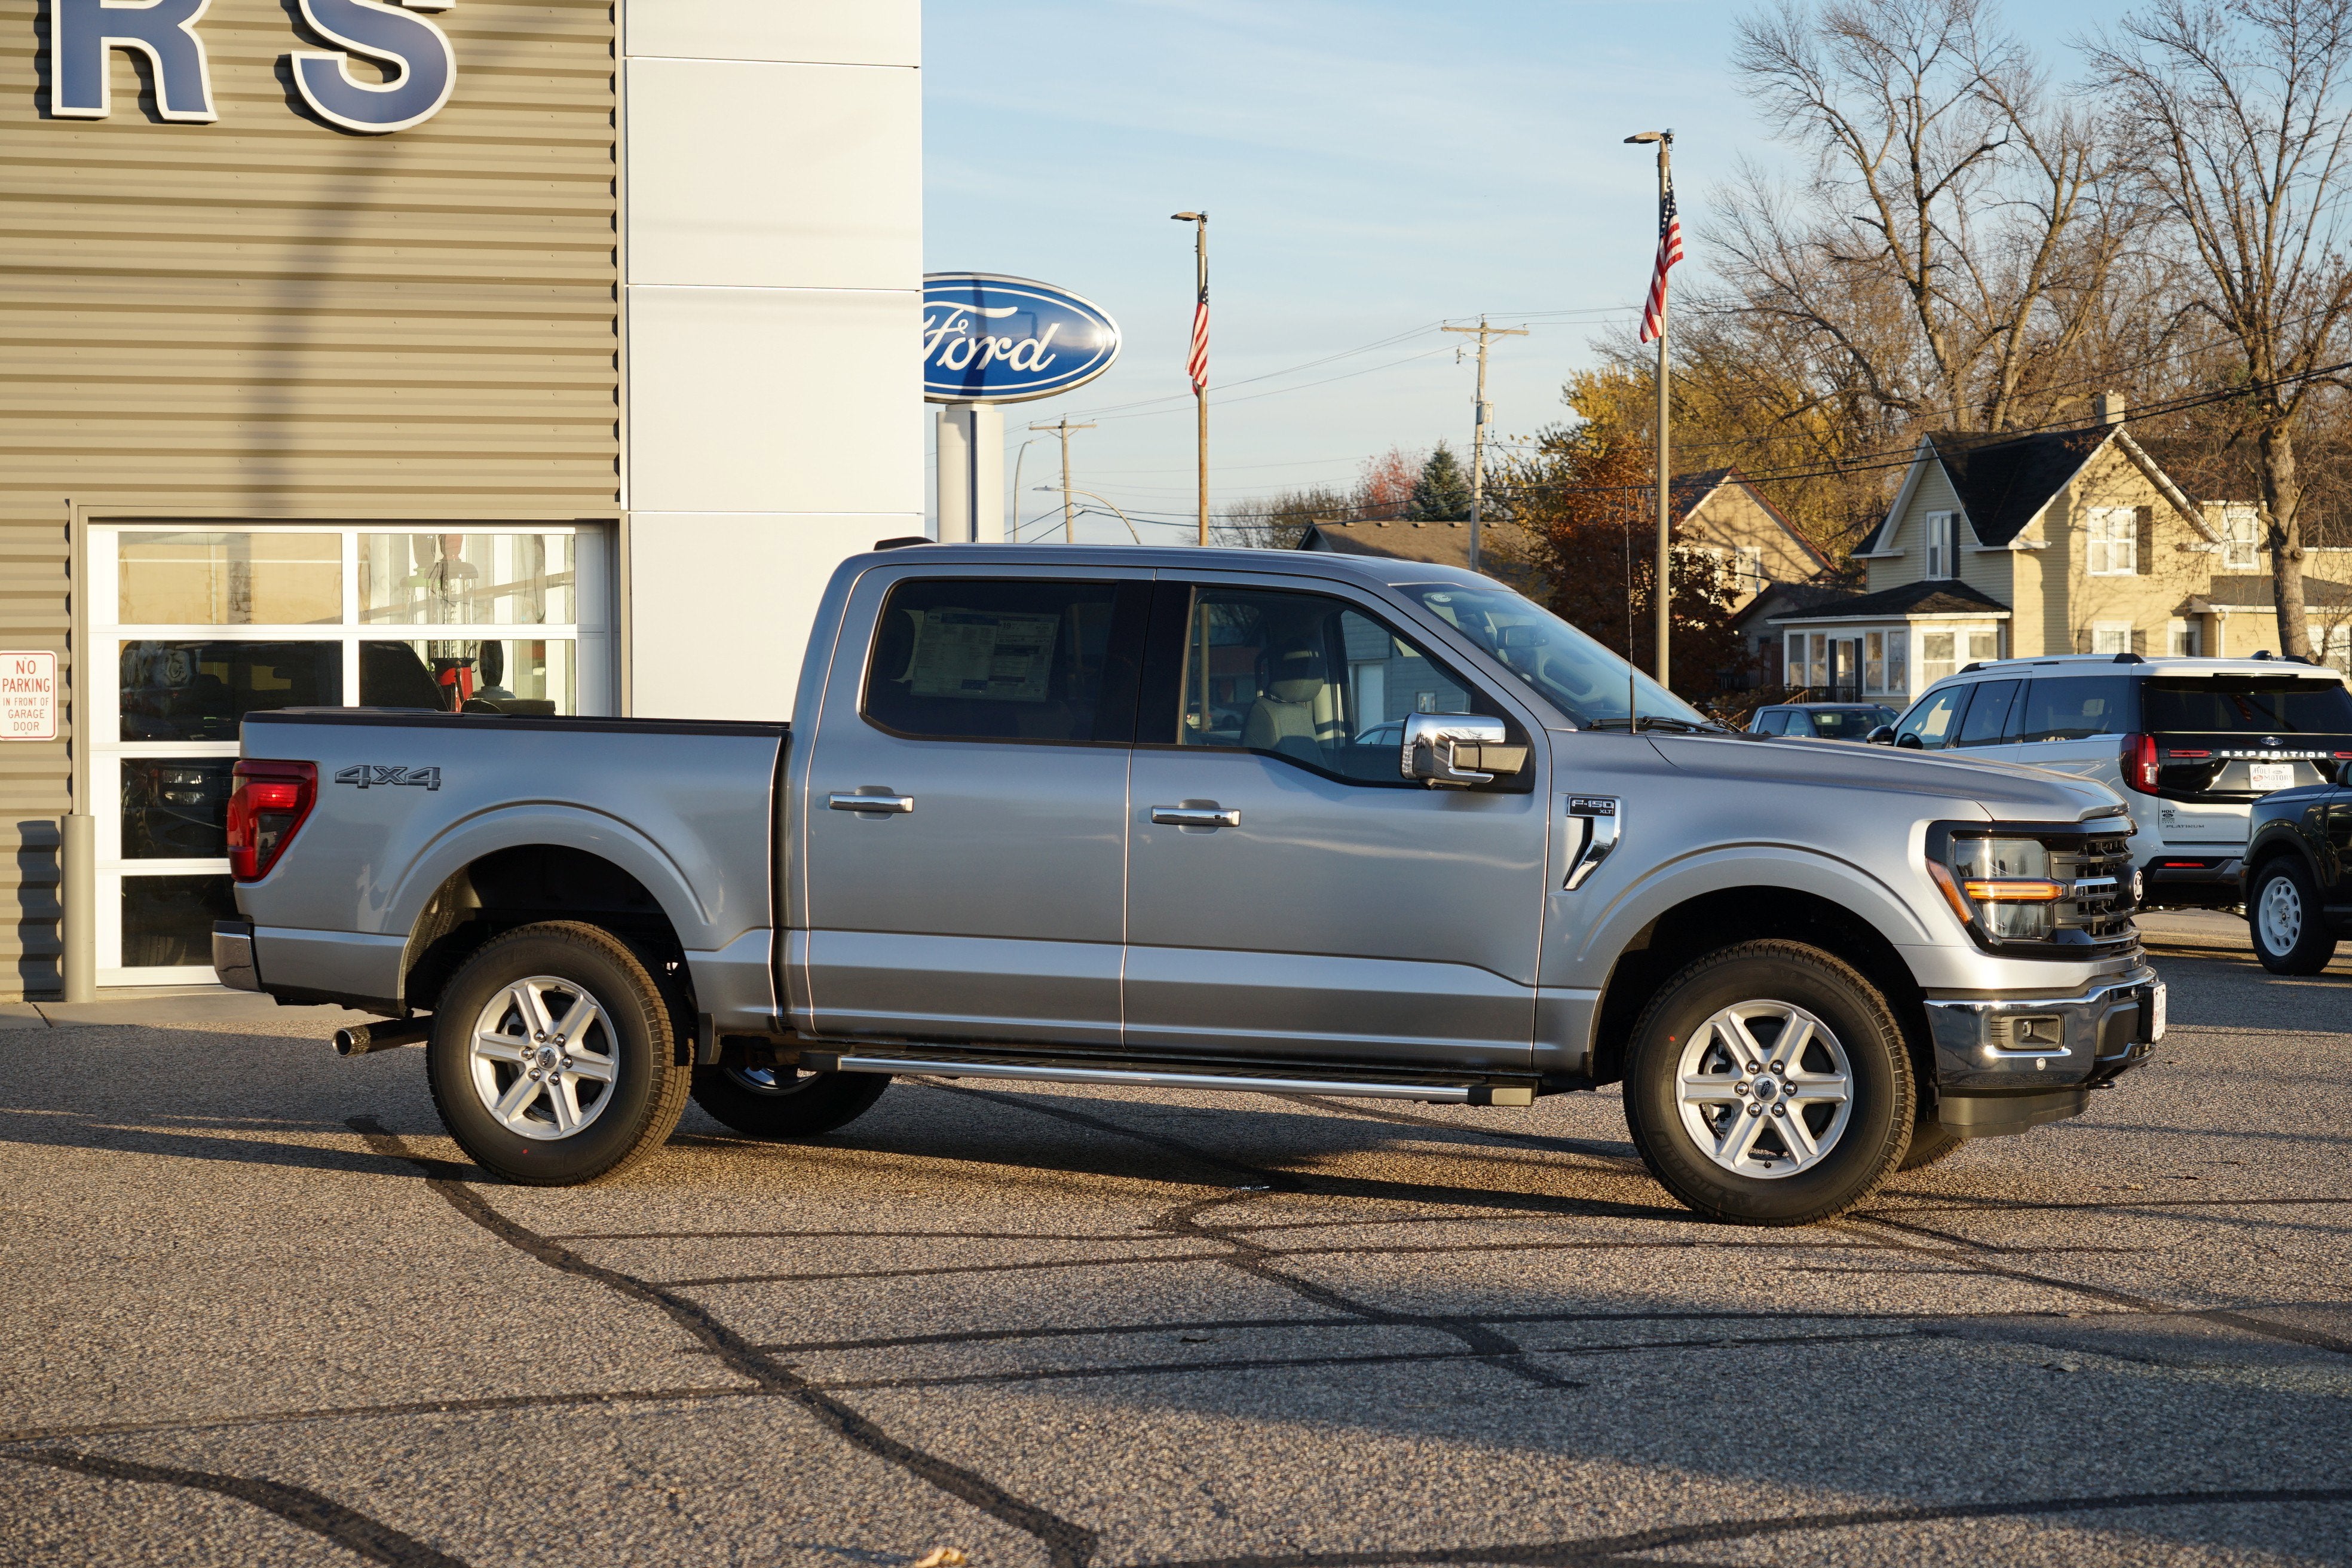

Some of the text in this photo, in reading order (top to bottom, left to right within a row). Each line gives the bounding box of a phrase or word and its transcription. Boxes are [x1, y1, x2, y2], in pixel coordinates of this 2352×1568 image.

[923, 301, 1061, 372] Ford
[16, 660, 36, 674] NO
[2, 678, 50, 692] PARKING
[3, 697, 49, 706] IN FRONT OF
[8, 709, 45, 718] GARAGE
[14, 722, 39, 731] DOOR
[1571, 800, 1614, 808] F-150
